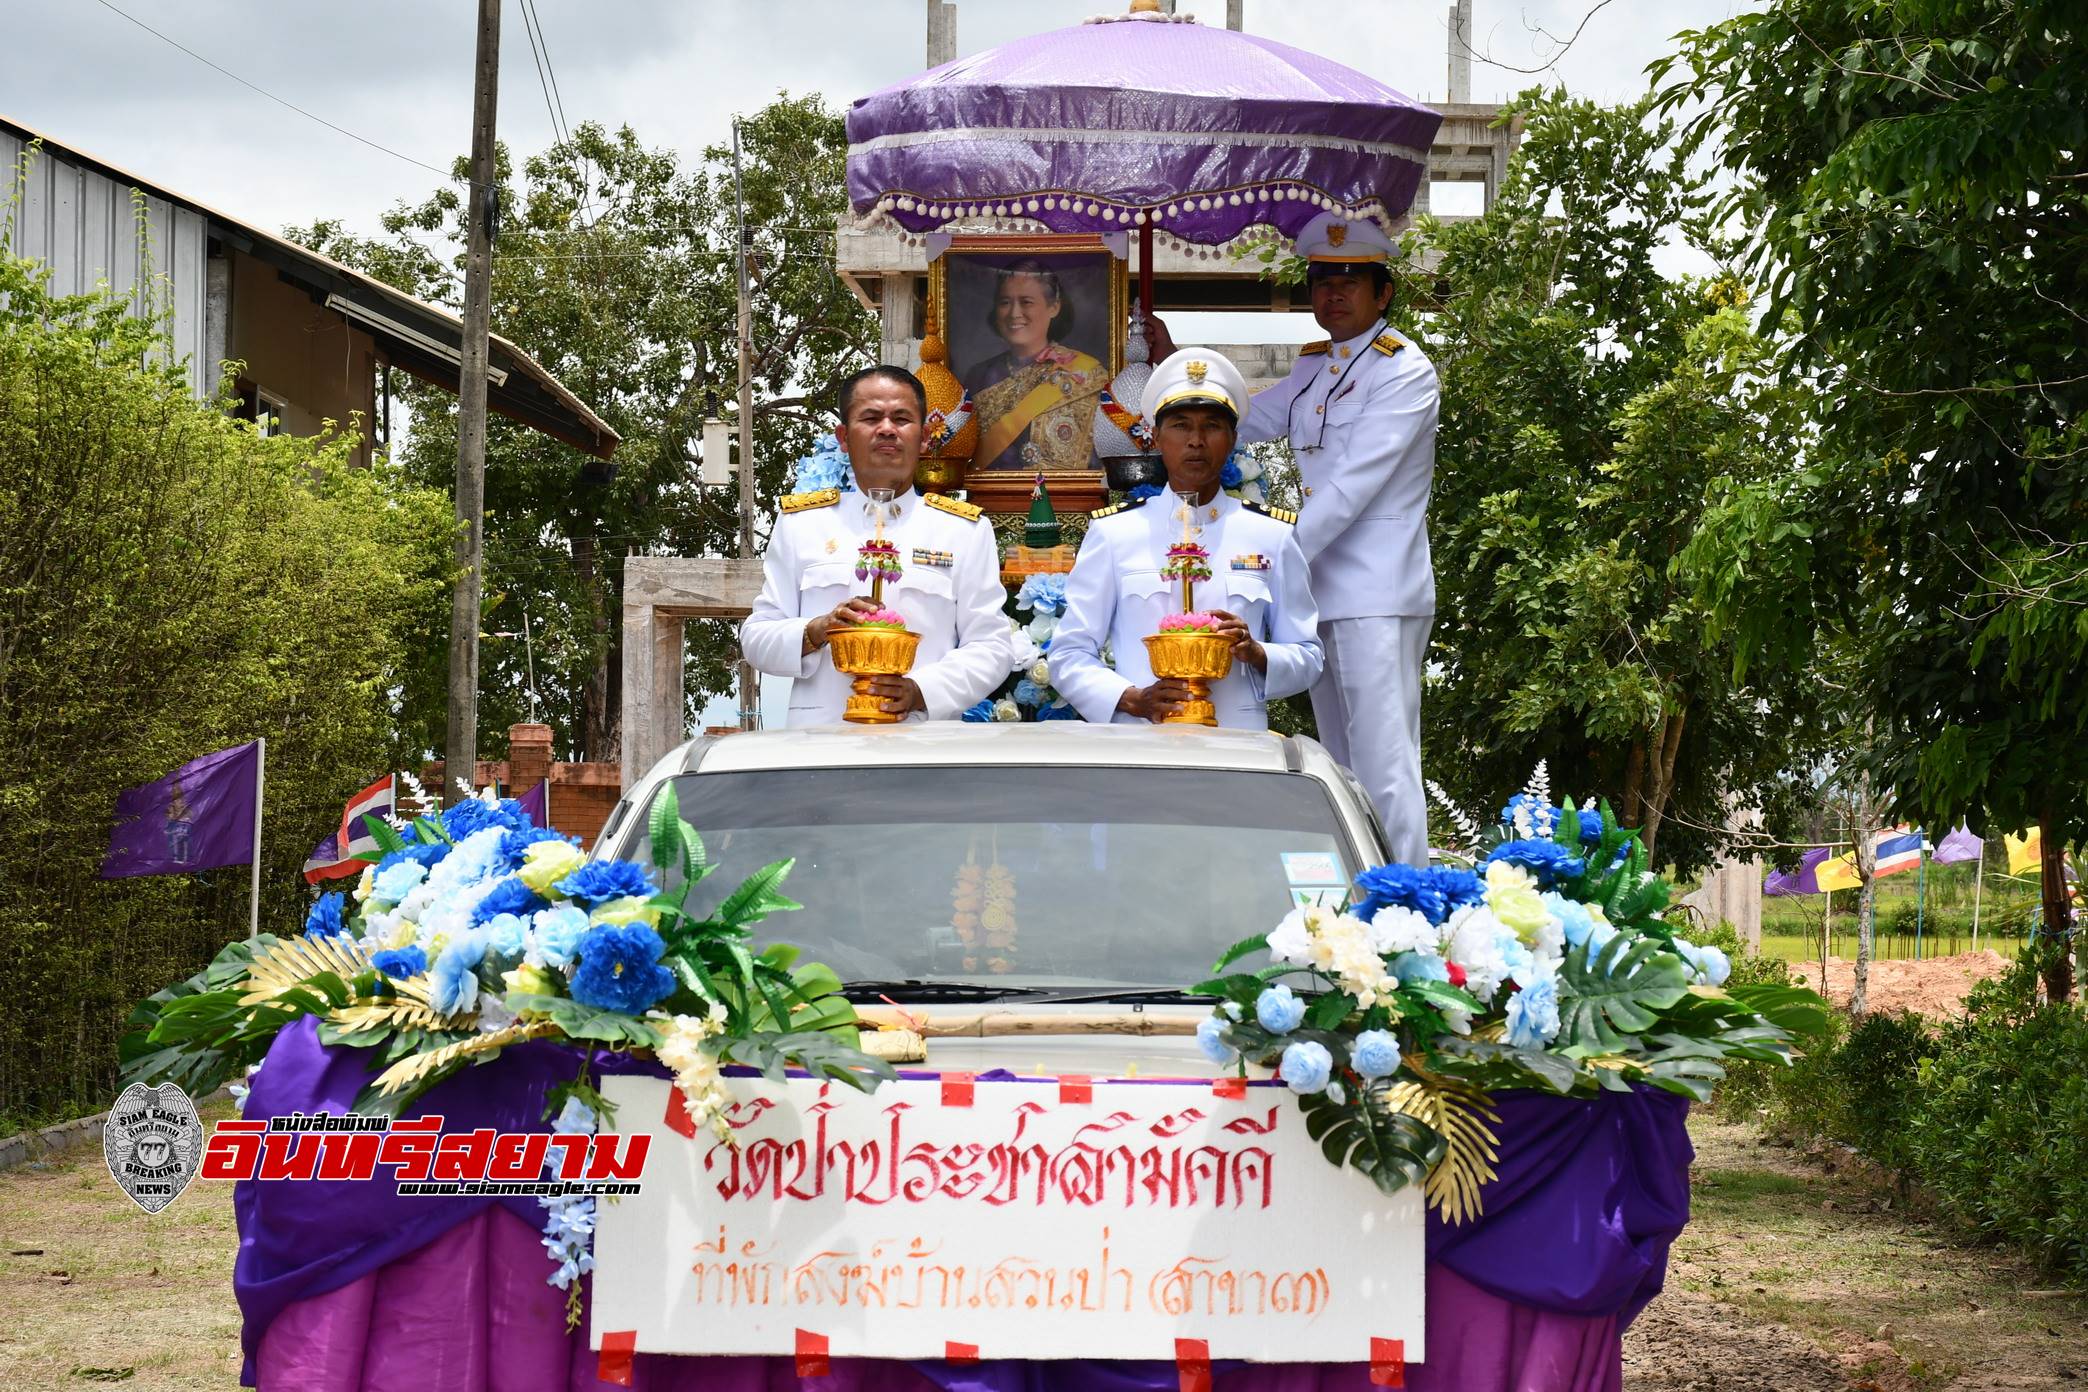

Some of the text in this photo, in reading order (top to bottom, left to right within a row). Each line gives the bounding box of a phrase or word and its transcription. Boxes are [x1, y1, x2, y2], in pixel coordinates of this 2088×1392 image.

[704, 1083, 1281, 1209] วัดป่าประชาสามัคคี
